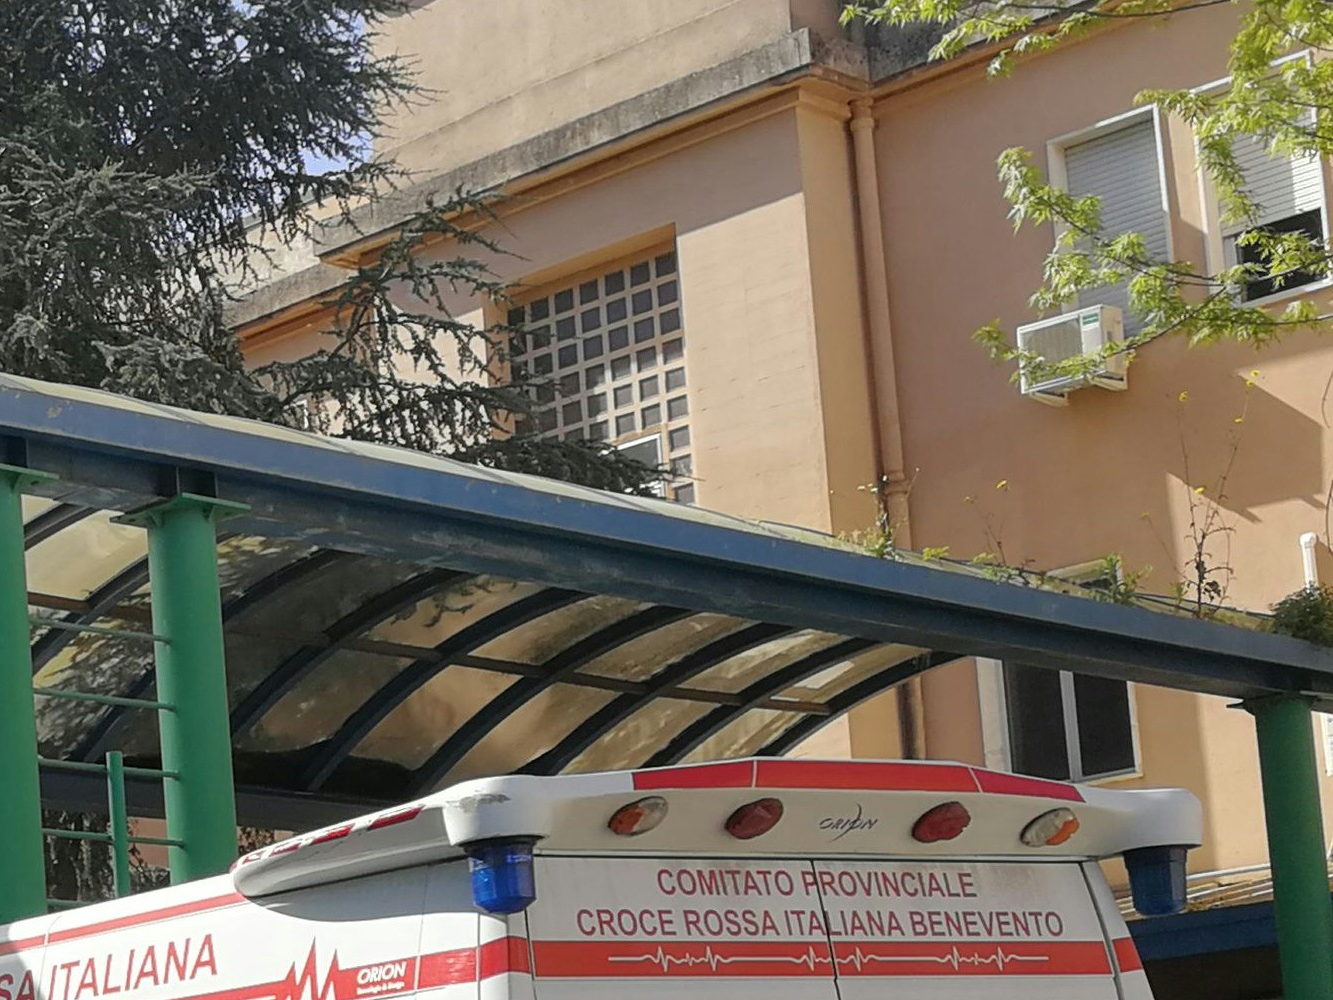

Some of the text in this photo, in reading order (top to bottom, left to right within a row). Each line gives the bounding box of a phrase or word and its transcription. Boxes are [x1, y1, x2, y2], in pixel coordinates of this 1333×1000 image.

[656, 869, 977, 898] COMITATO PROVINCIALE
[577, 909, 1064, 937] CROCE ROSSA ITALIANA BENEVENTO
[357, 962, 407, 984] ORION
